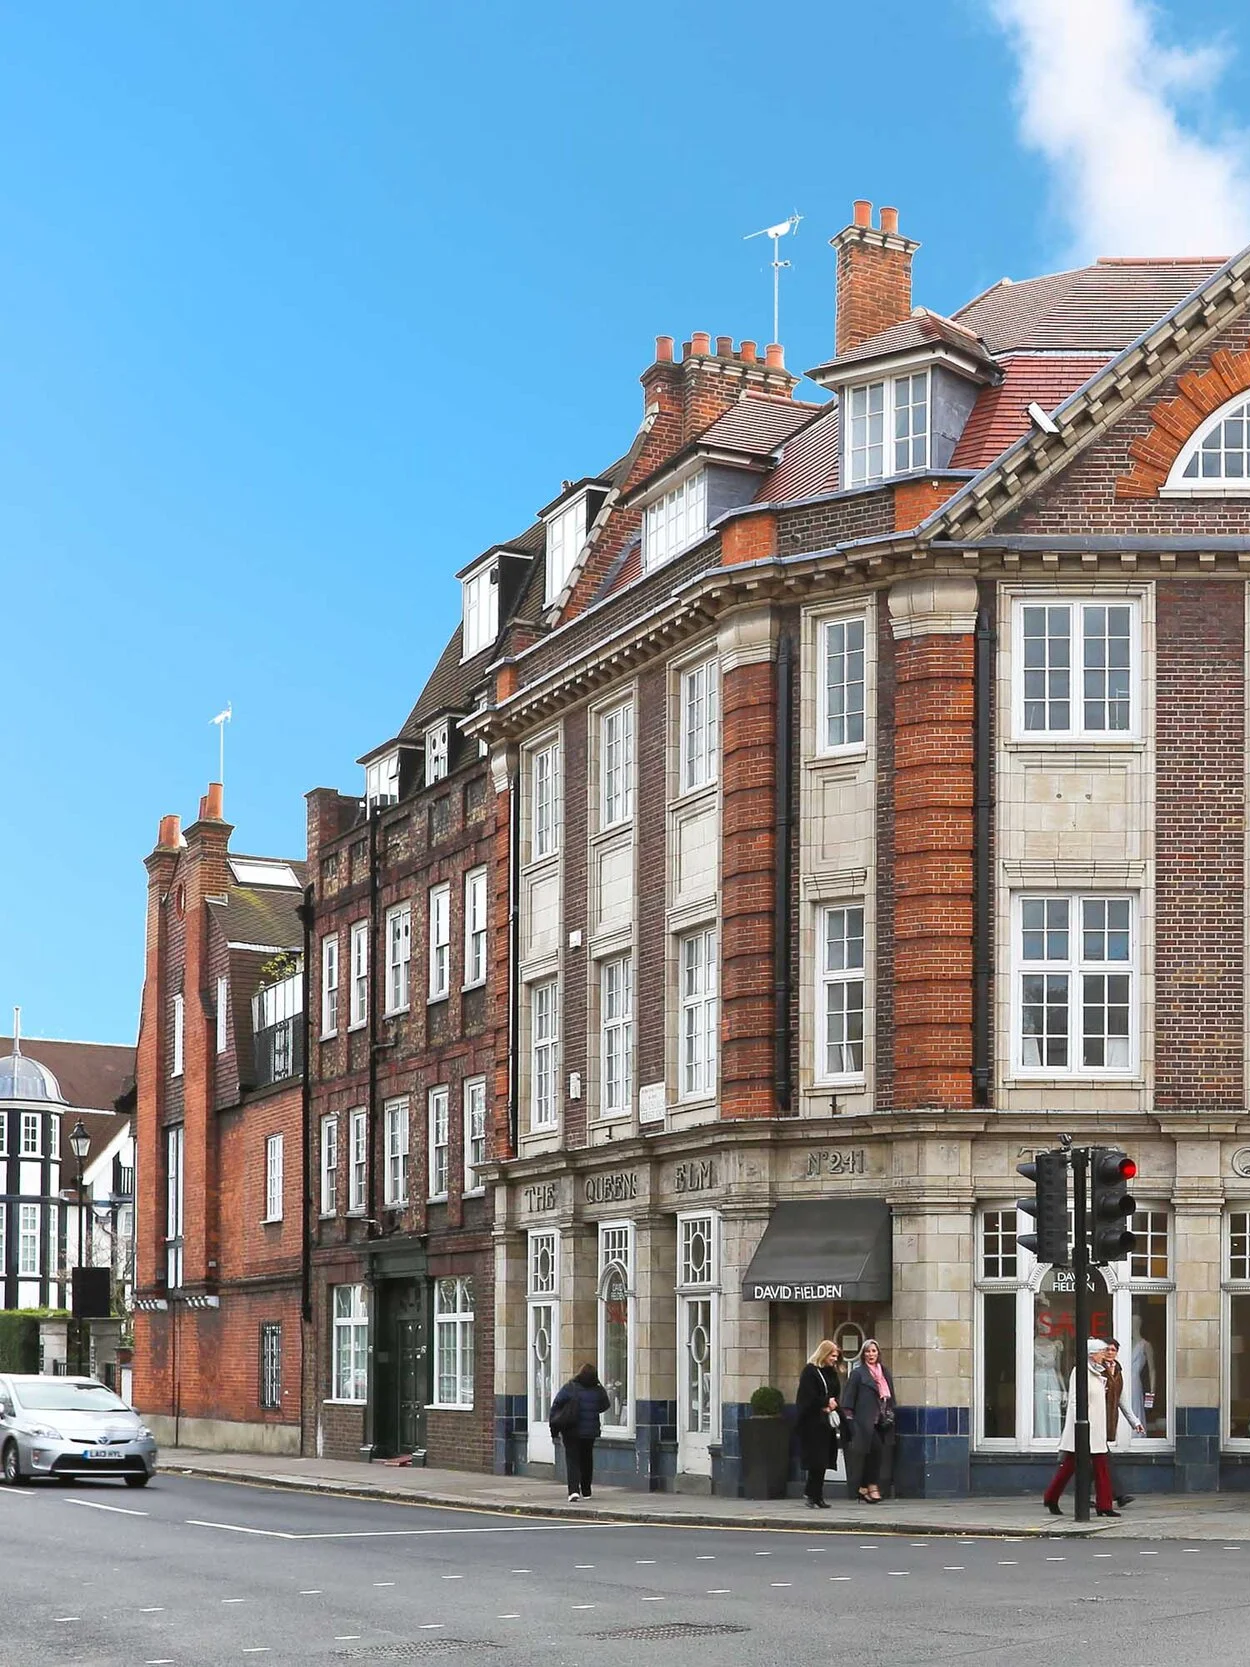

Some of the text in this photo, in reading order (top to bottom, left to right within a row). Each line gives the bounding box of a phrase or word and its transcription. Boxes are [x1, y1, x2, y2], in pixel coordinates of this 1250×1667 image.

[524, 1184, 555, 1213] THE
[675, 1160, 713, 1193] ELM
[754, 1284, 842, 1299] DAVID FIELDEN
[1038, 1311, 1108, 1338] SAE
